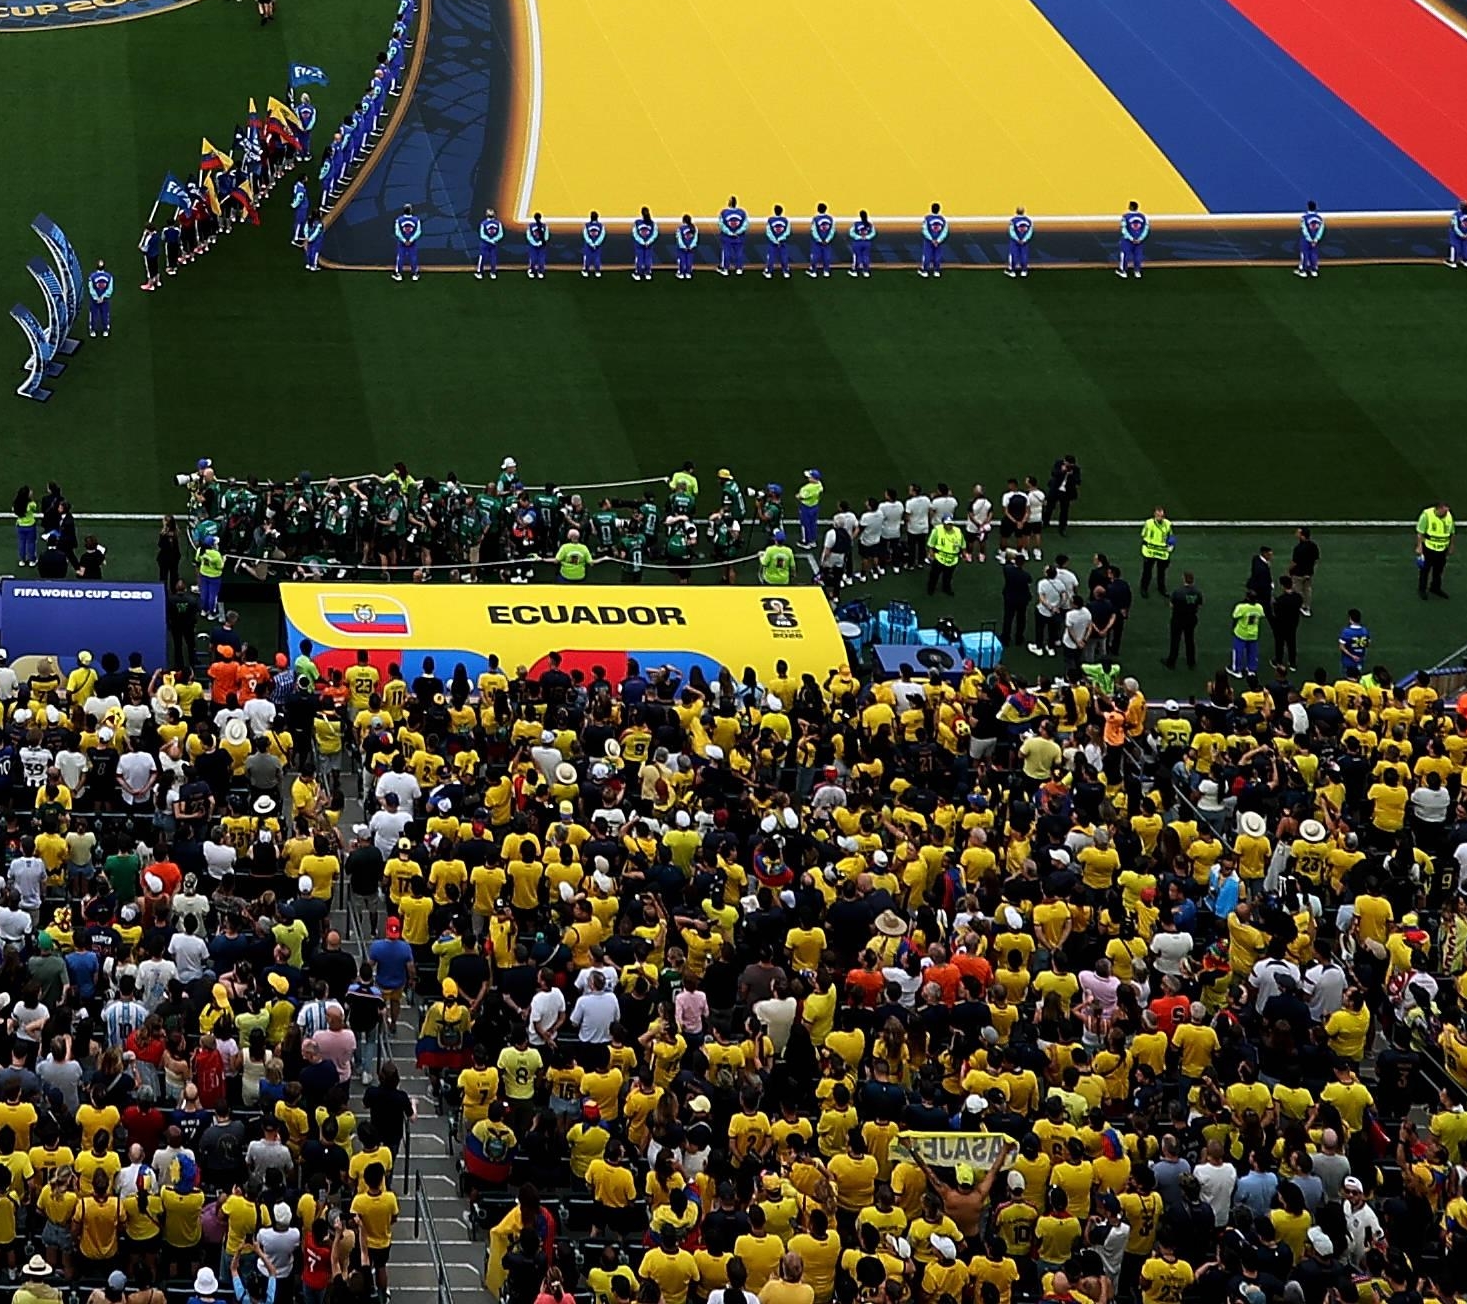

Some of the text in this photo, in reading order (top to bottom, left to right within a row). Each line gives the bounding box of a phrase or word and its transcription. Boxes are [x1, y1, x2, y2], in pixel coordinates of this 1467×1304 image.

[14, 588, 152, 600] FIFA WORLD CUP 2026
[488, 605, 686, 625] ECUADOR
[355, 680, 372, 694] 23
[635, 743, 643, 754] 9
[0, 759, 10, 774] 10
[25, 764, 45, 773] 39
[516, 1069, 529, 1084] 8
[479, 1090, 489, 1105] 7
[1013, 1225, 1031, 1243] 10
